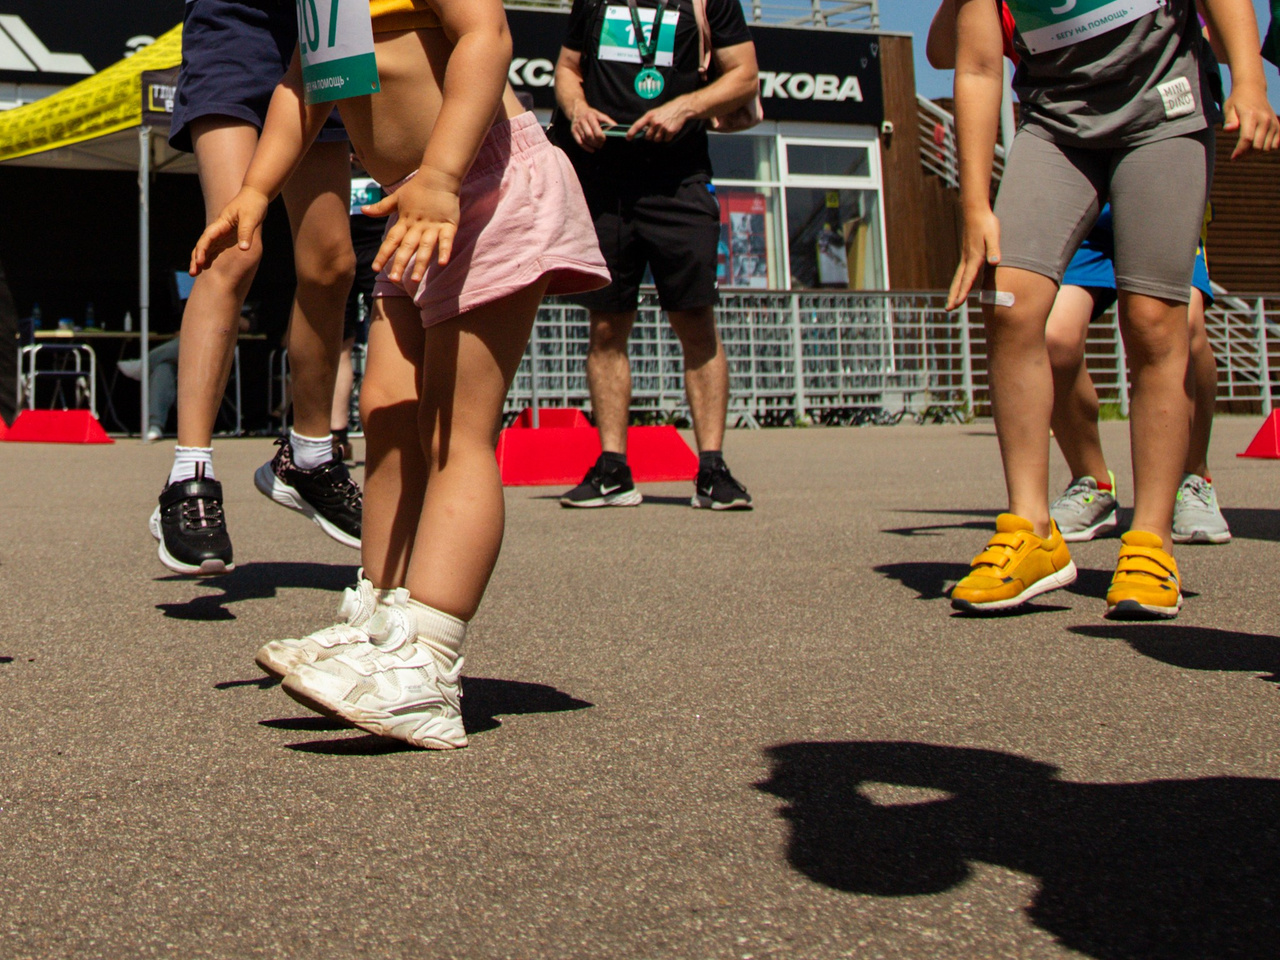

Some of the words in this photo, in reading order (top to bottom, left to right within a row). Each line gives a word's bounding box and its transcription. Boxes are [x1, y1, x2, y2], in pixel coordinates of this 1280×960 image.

[1055, 28, 1074, 41] БЕГУ
[1075, 25, 1088, 35] НА
[1087, 9, 1129, 30] ПОМОЩЬ
[318, 75, 345, 89] ПОМОЩЬ
[1163, 81, 1187, 97] MINI
[1168, 93, 1191, 110] DINO
